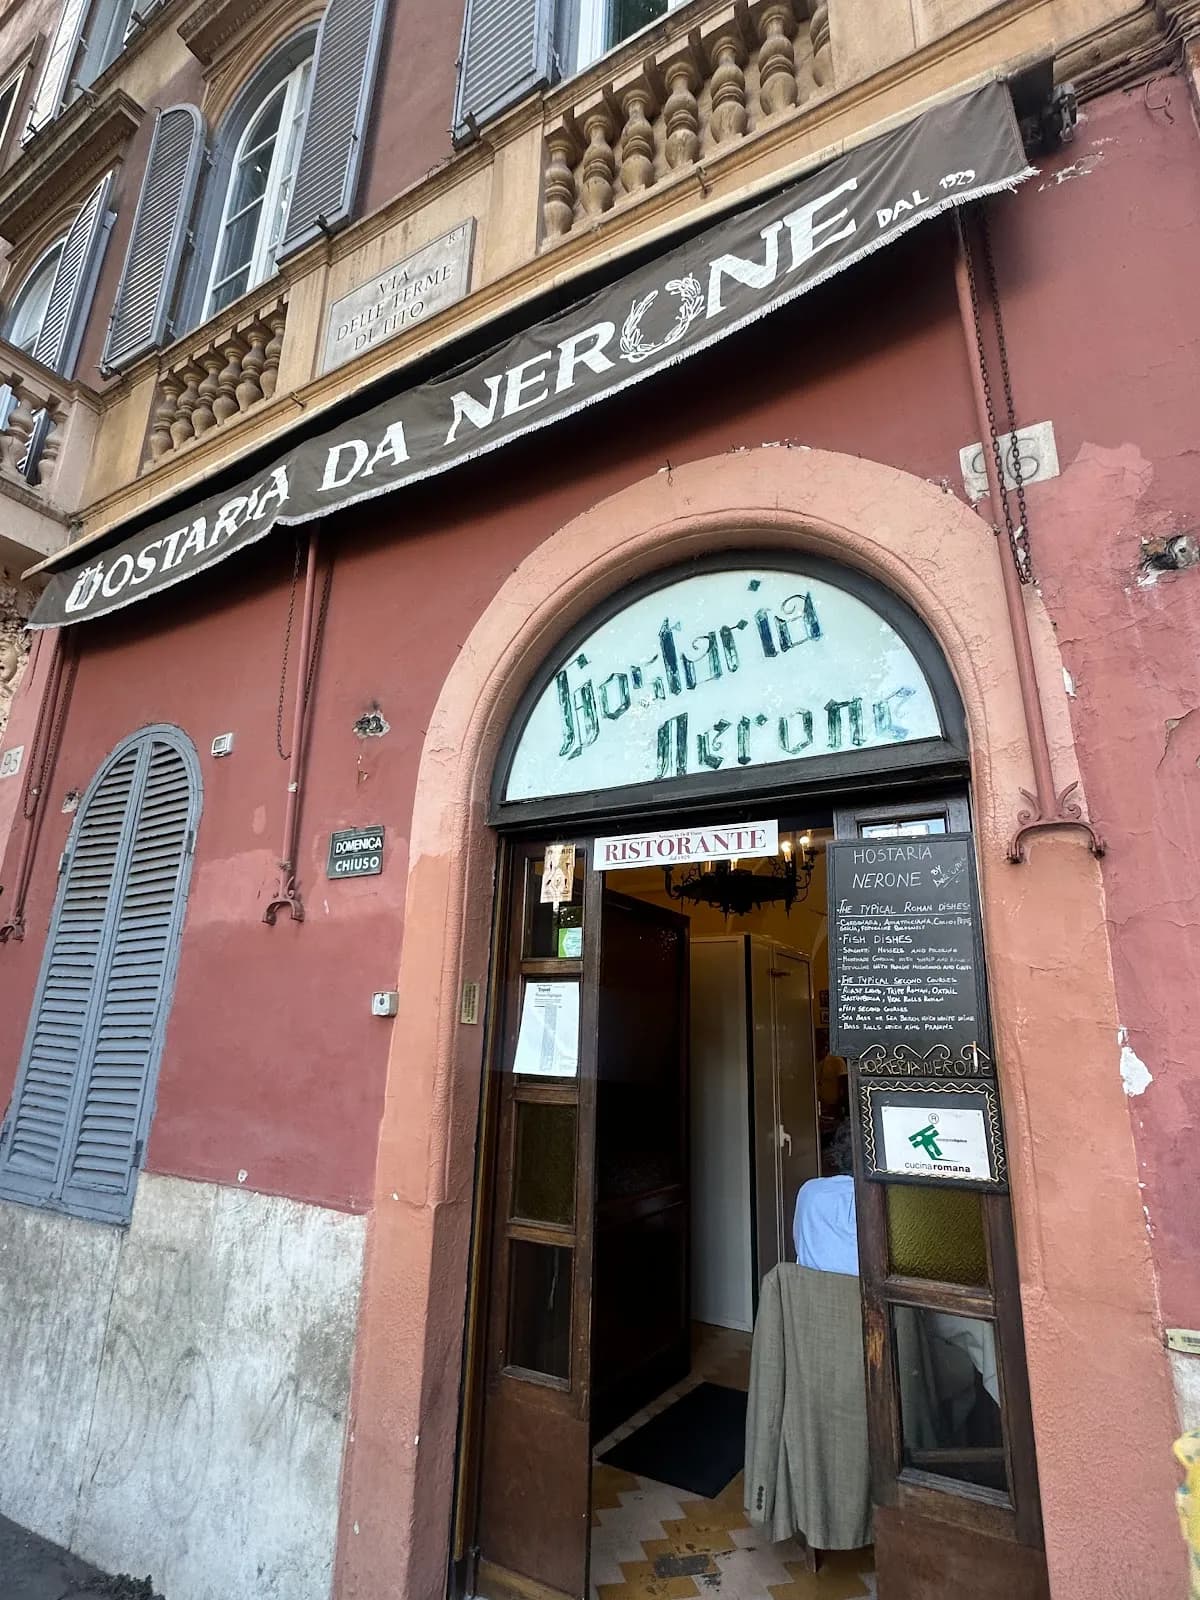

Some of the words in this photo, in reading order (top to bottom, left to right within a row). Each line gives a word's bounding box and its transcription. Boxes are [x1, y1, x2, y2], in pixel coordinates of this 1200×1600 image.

[378, 269, 410, 295] VIA
[336, 300, 385, 342] DELLE
[391, 264, 453, 309] TERME
[316, 420, 410, 493] DA
[442, 176, 858, 446] NERONE
[876, 190, 930, 229] DAL
[354, 327, 374, 351] DI
[383, 301, 425, 335] TITO
[335, 837, 383, 854] DOMENICA
[604, 828, 767, 863] RISTORANTE
[335, 856, 380, 873] CHIUSO
[852, 871, 922, 889] NERONE
[904, 901, 933, 912] ROMAN
[843, 934, 866, 945] FISH
[931, 986, 958, 995] OXTAIL
